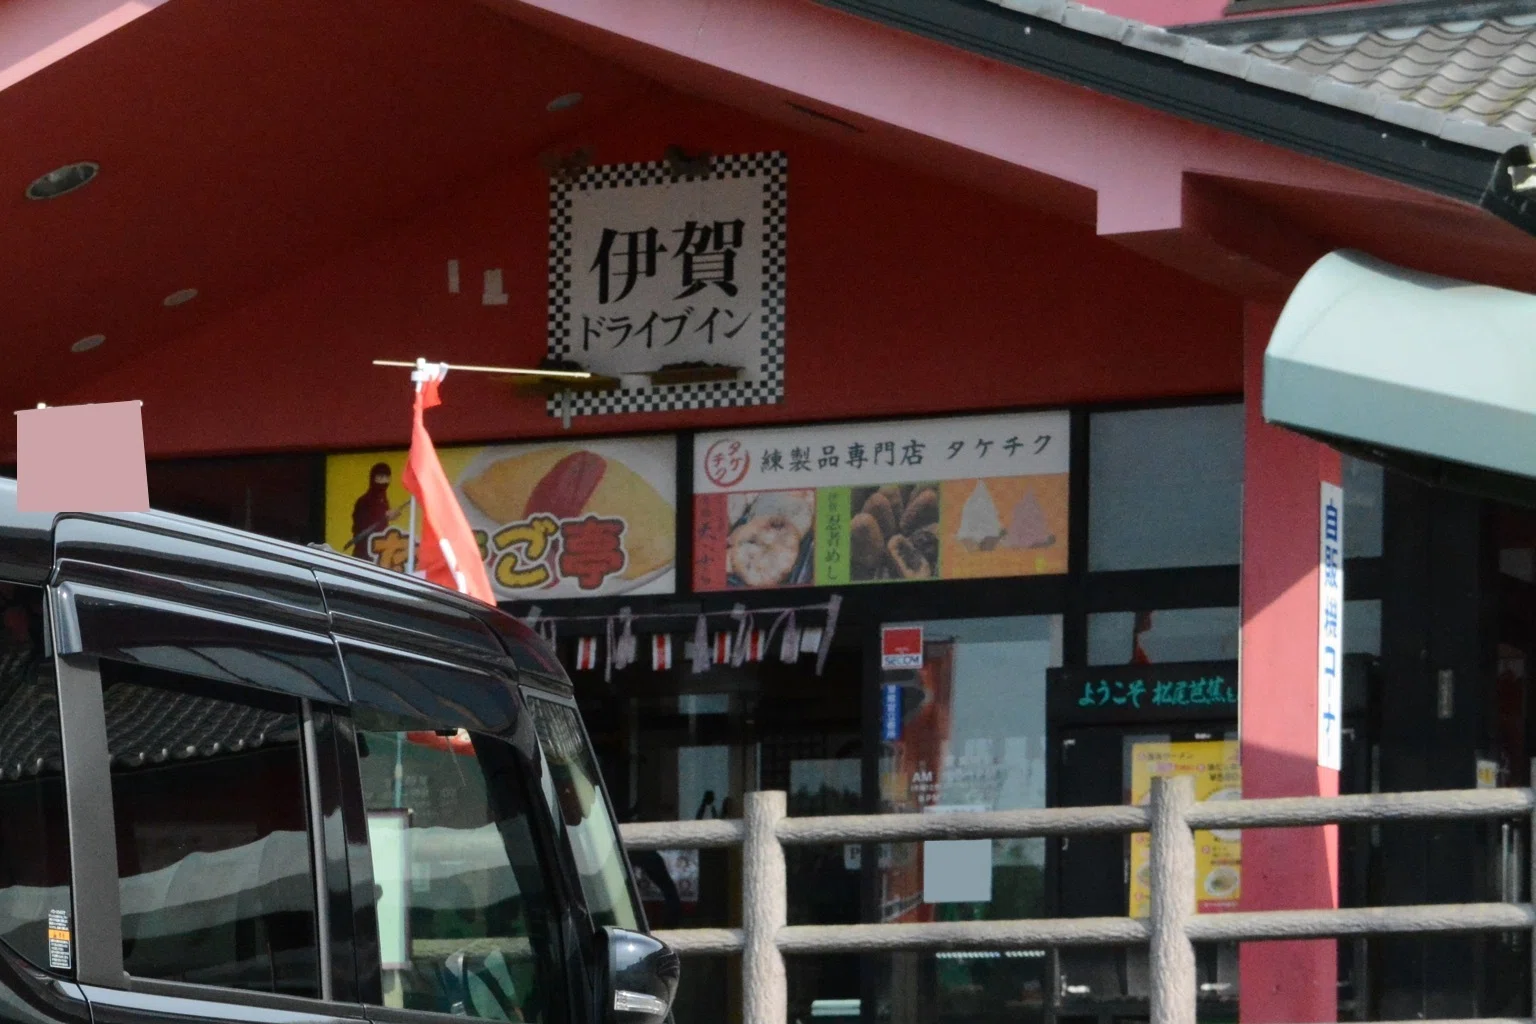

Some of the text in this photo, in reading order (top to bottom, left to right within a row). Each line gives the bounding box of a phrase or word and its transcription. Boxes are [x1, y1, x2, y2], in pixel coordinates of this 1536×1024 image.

[589, 218, 745, 304] 伊賀
[582, 306, 753, 351] ドライブイン
[760, 435, 1052, 473] 練製品専門店 タケチク
[370, 516, 625, 590] たご亭
[884, 655, 920, 666] SECOM
[1078, 679, 1146, 709] ようこそ
